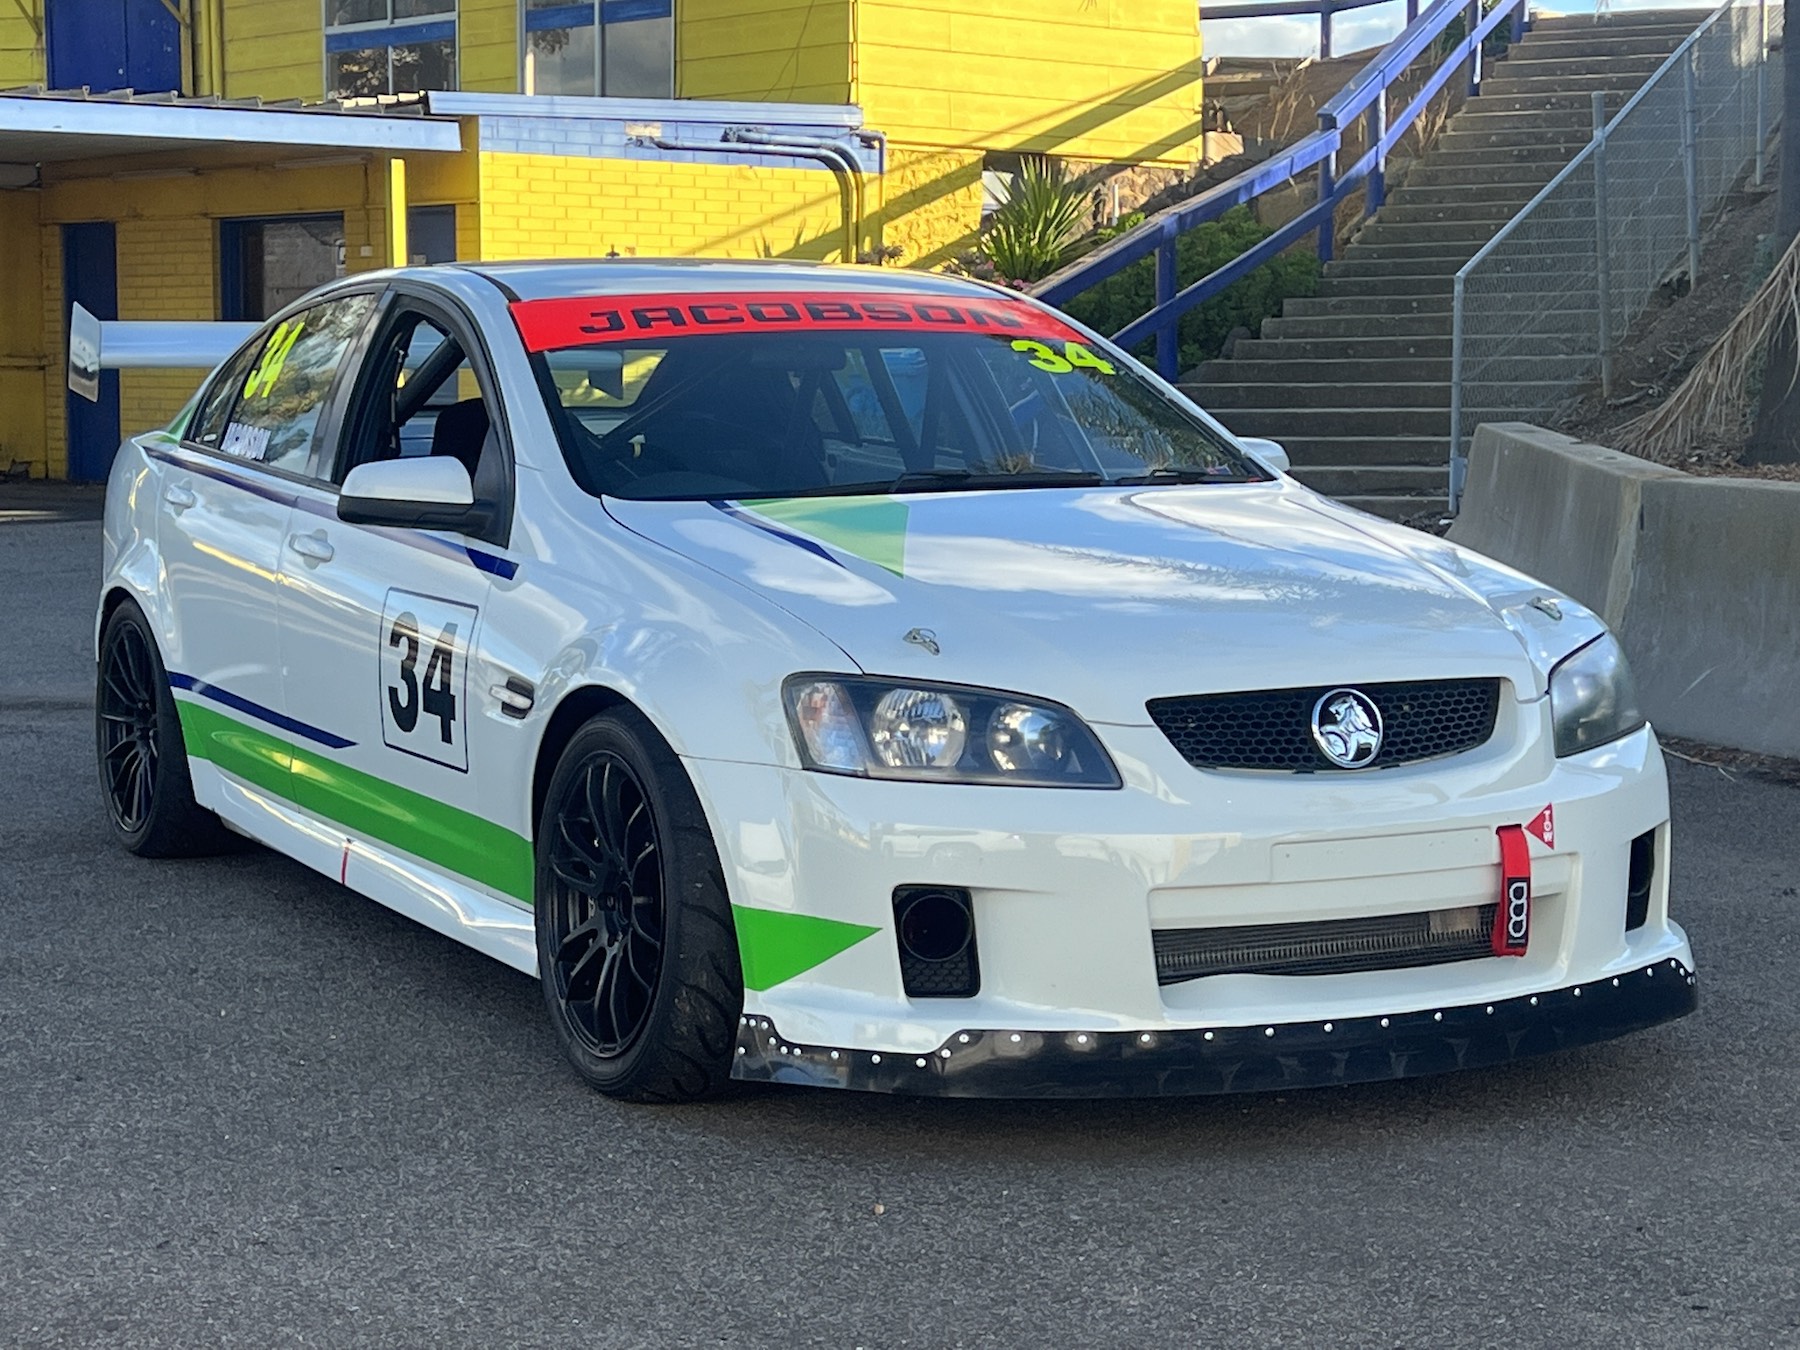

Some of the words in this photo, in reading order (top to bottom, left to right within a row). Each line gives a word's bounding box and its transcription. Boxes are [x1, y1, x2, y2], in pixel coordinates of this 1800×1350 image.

[579, 301, 1024, 334] JACOBSON
[244, 322, 305, 399] 34
[1010, 339, 1116, 375] 34
[388, 611, 458, 745] 34
[1543, 810, 1553, 842] TOW
